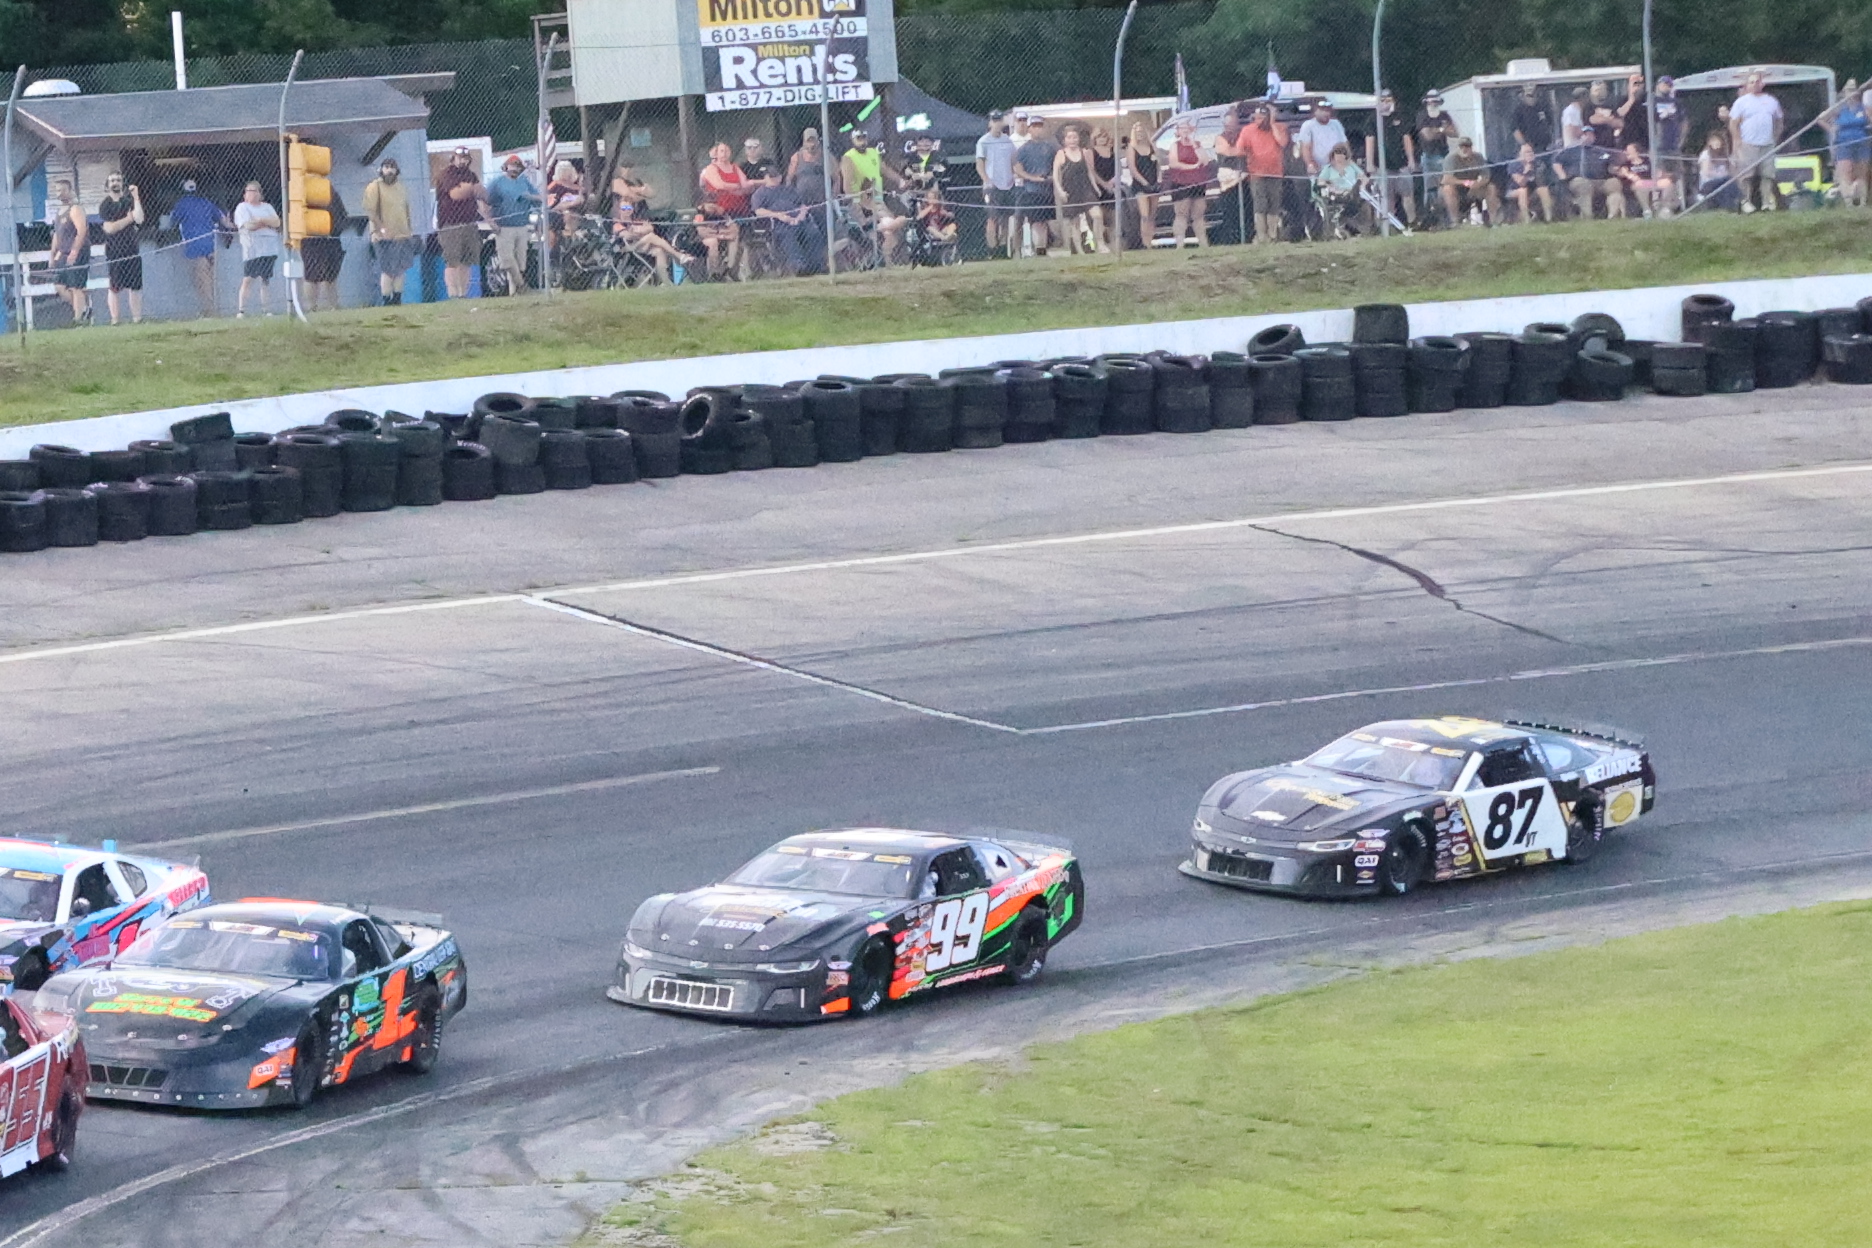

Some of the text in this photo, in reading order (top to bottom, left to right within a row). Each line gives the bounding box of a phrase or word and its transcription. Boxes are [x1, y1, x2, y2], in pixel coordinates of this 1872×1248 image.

[718, 45, 858, 89] Rents
[757, 44, 810, 57] Milton
[1484, 787, 1544, 851] 87
[927, 892, 991, 972] 99
